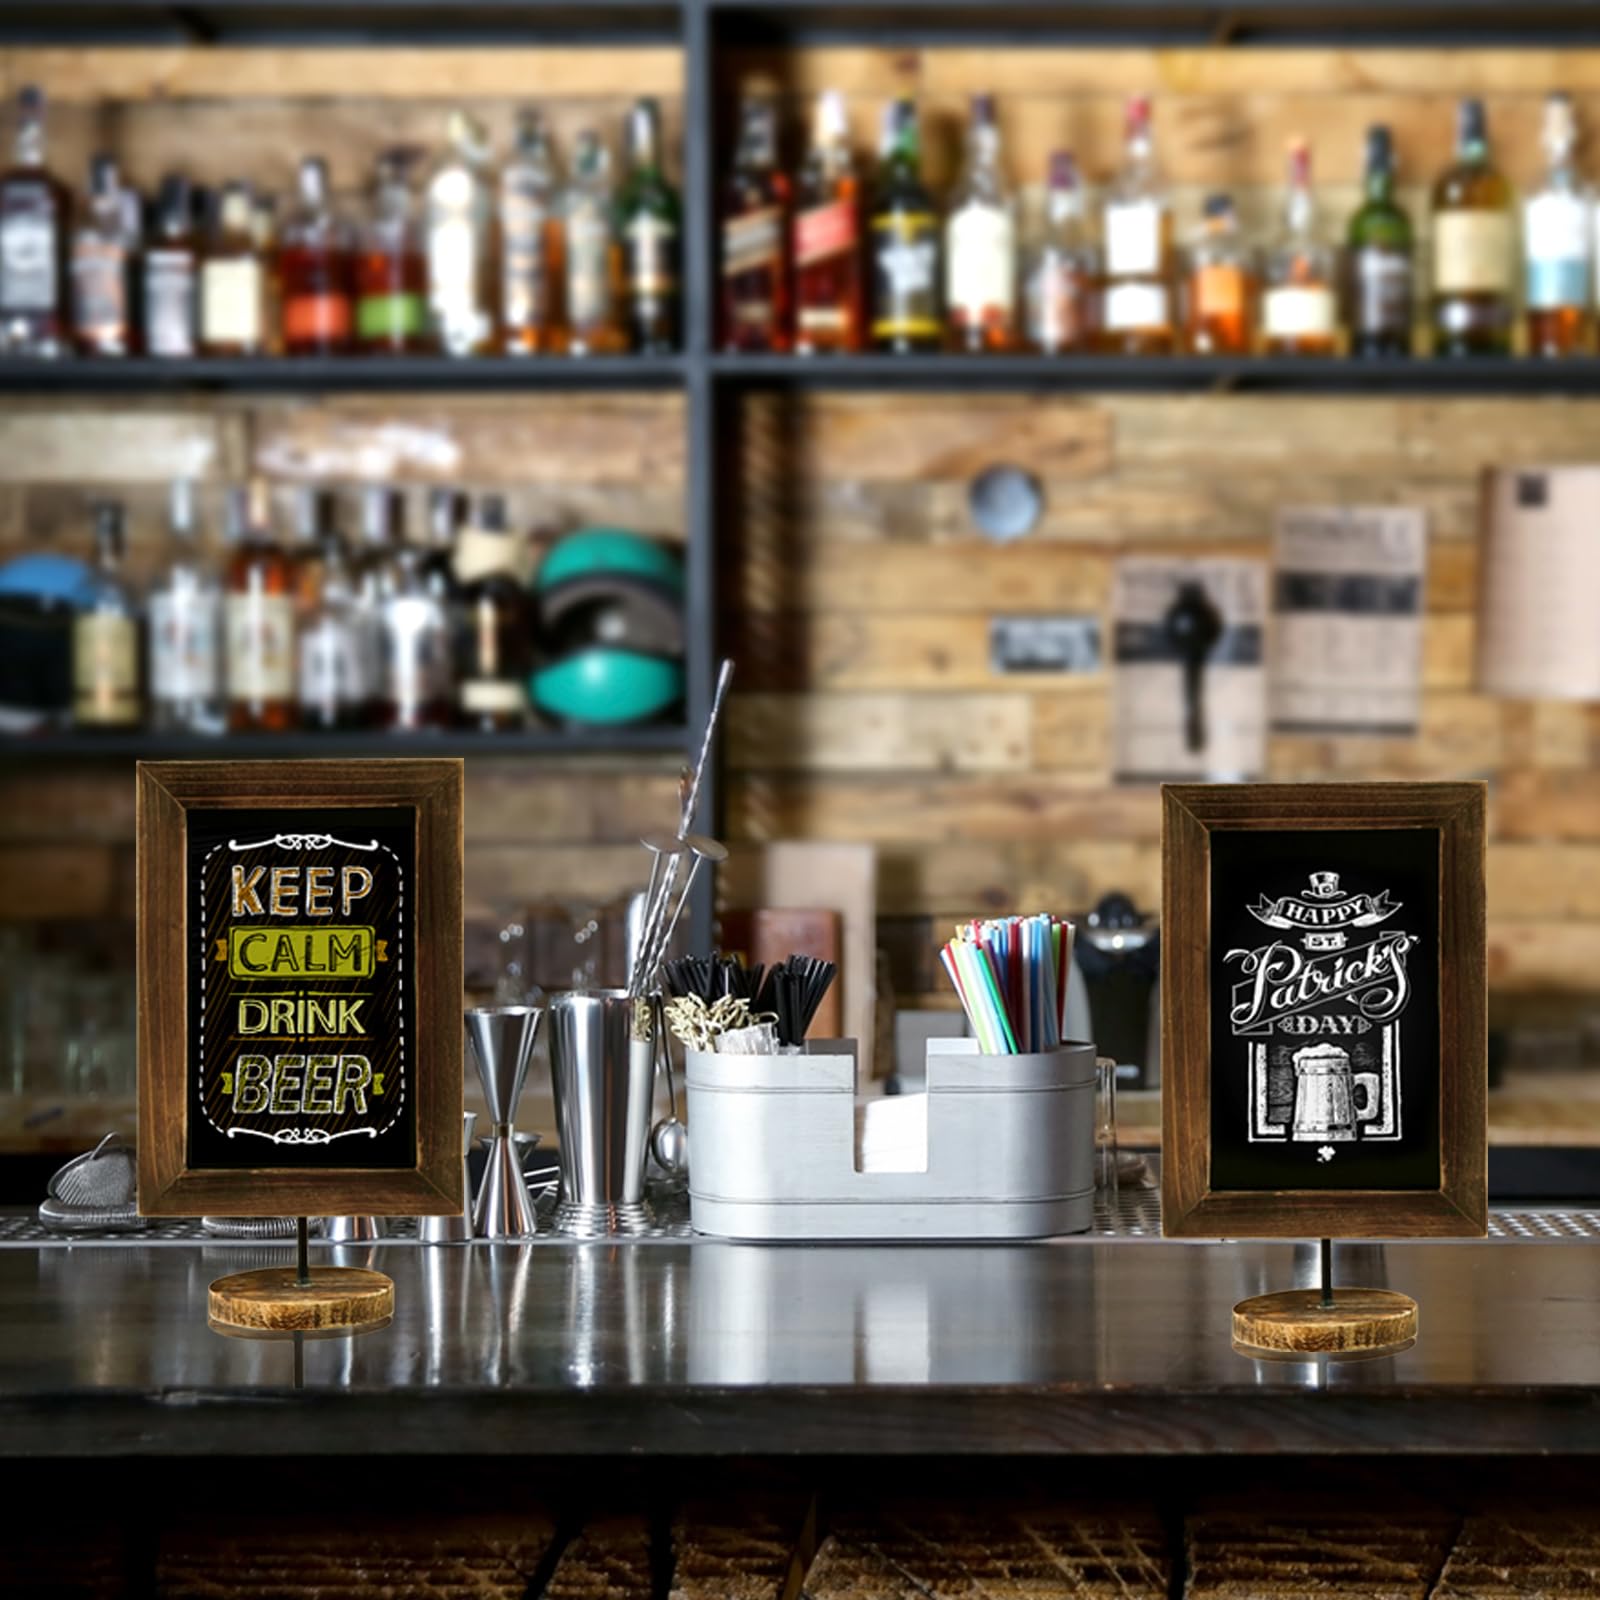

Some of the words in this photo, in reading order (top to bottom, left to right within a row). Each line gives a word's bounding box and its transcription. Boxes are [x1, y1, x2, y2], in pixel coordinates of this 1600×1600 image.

[232, 865, 373, 917] KEEP
[1286, 900, 1364, 924] HAPPY
[240, 933, 363, 972] CALM
[1311, 936, 1338, 947] ST.
[238, 1000, 365, 1034] DRINK
[1294, 1015, 1357, 1035] DAY
[232, 1054, 373, 1115] BEER
